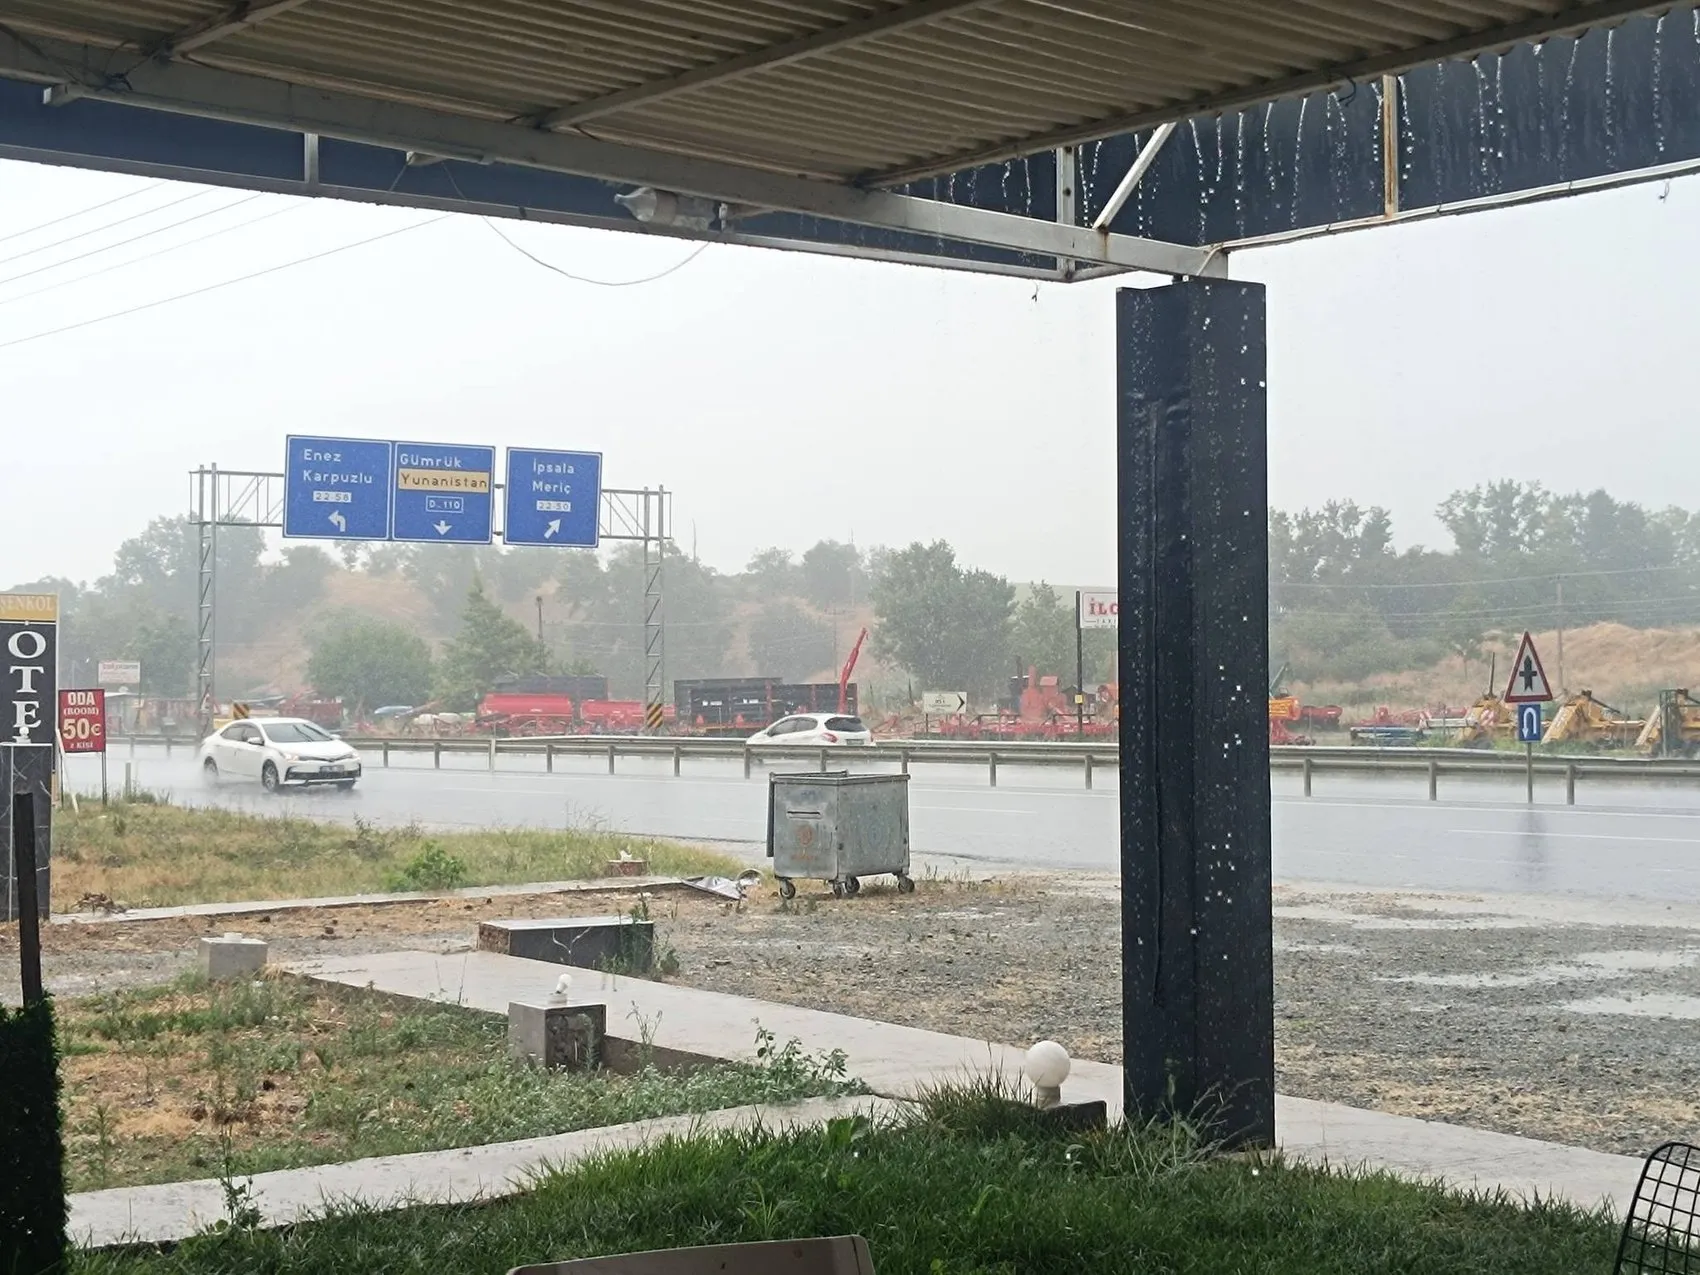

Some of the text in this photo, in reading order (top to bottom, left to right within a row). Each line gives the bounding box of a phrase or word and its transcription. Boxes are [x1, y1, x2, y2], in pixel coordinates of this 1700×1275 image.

[303, 448, 342, 462] Enez
[400, 453, 462, 468] Gümrük
[533, 457, 575, 475] İpsala
[302, 469, 373, 485] Karpuzlu
[401, 472, 488, 488] Yunanistan
[532, 480, 571, 494] Meriç
[67, 691, 96, 706] ODA
[63, 707, 99, 716] (ROOM)
